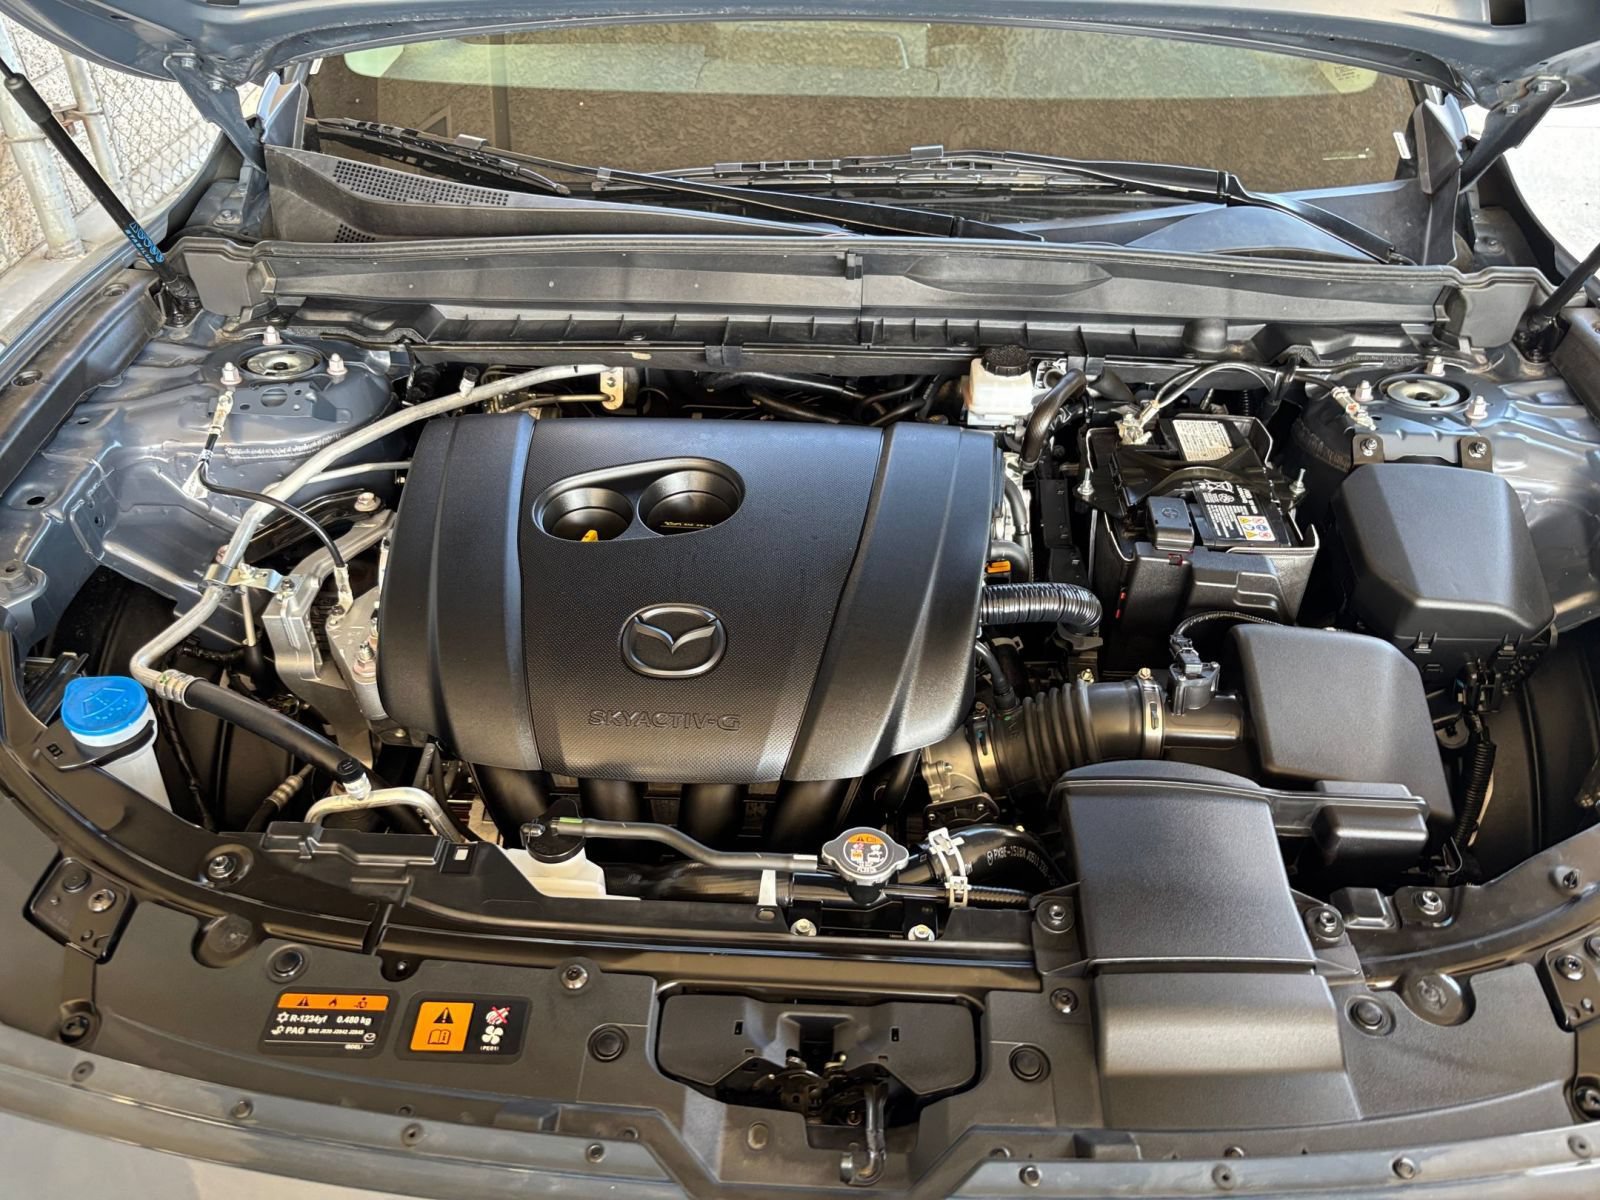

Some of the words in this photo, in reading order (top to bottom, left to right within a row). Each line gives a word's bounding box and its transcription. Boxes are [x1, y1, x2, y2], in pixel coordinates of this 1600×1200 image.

[125, 229, 155, 264] STABILUS
[587, 709, 742, 732] SKYACTIV-G
[289, 1014, 328, 1025] R-1234yf
[336, 1015, 360, 1024] 0.480
[360, 1016, 372, 1026] kg
[285, 1026, 306, 1035] PAG
